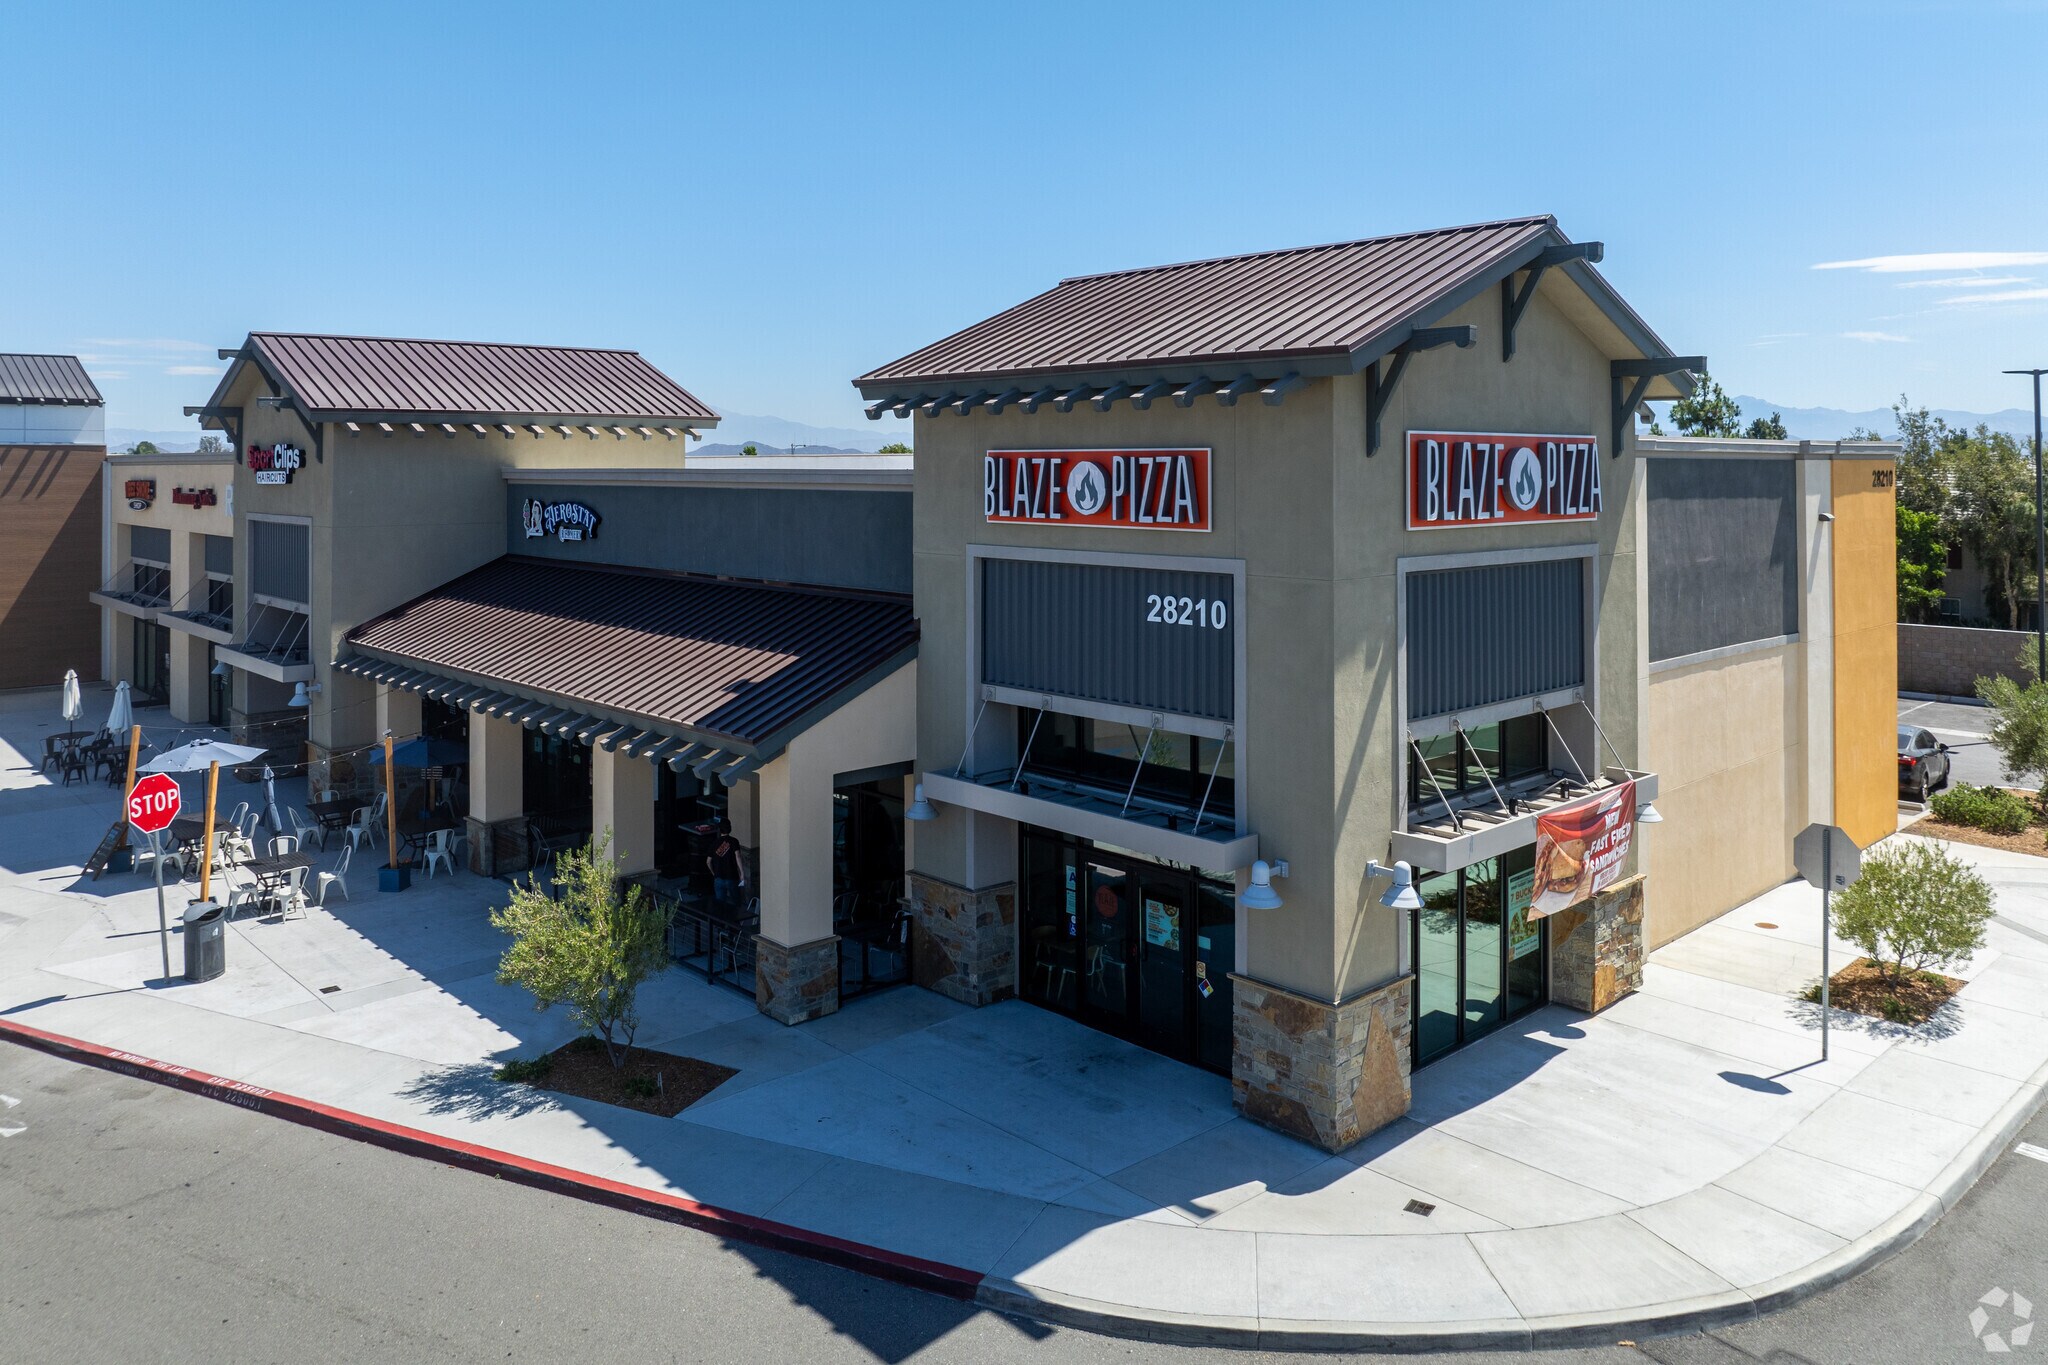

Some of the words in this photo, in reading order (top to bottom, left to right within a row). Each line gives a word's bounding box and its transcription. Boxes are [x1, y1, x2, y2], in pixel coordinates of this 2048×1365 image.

[257, 471, 287, 484] HAIRCUTS
[984, 456, 1062, 520] BLAZE
[1112, 455, 1195, 524] PIZZA
[1426, 439, 1505, 521] BLAZE
[1547, 442, 1603, 515] PIZZA
[1872, 469, 1894, 488] 28210
[544, 502, 597, 538] AEROSTAT
[1146, 594, 1227, 631] 28210
[130, 787, 179, 820] STOP
[1604, 809, 1620, 830] NEW
[1590, 833, 1609, 855] FAST
[1590, 839, 1630, 875] SANDWICHES
